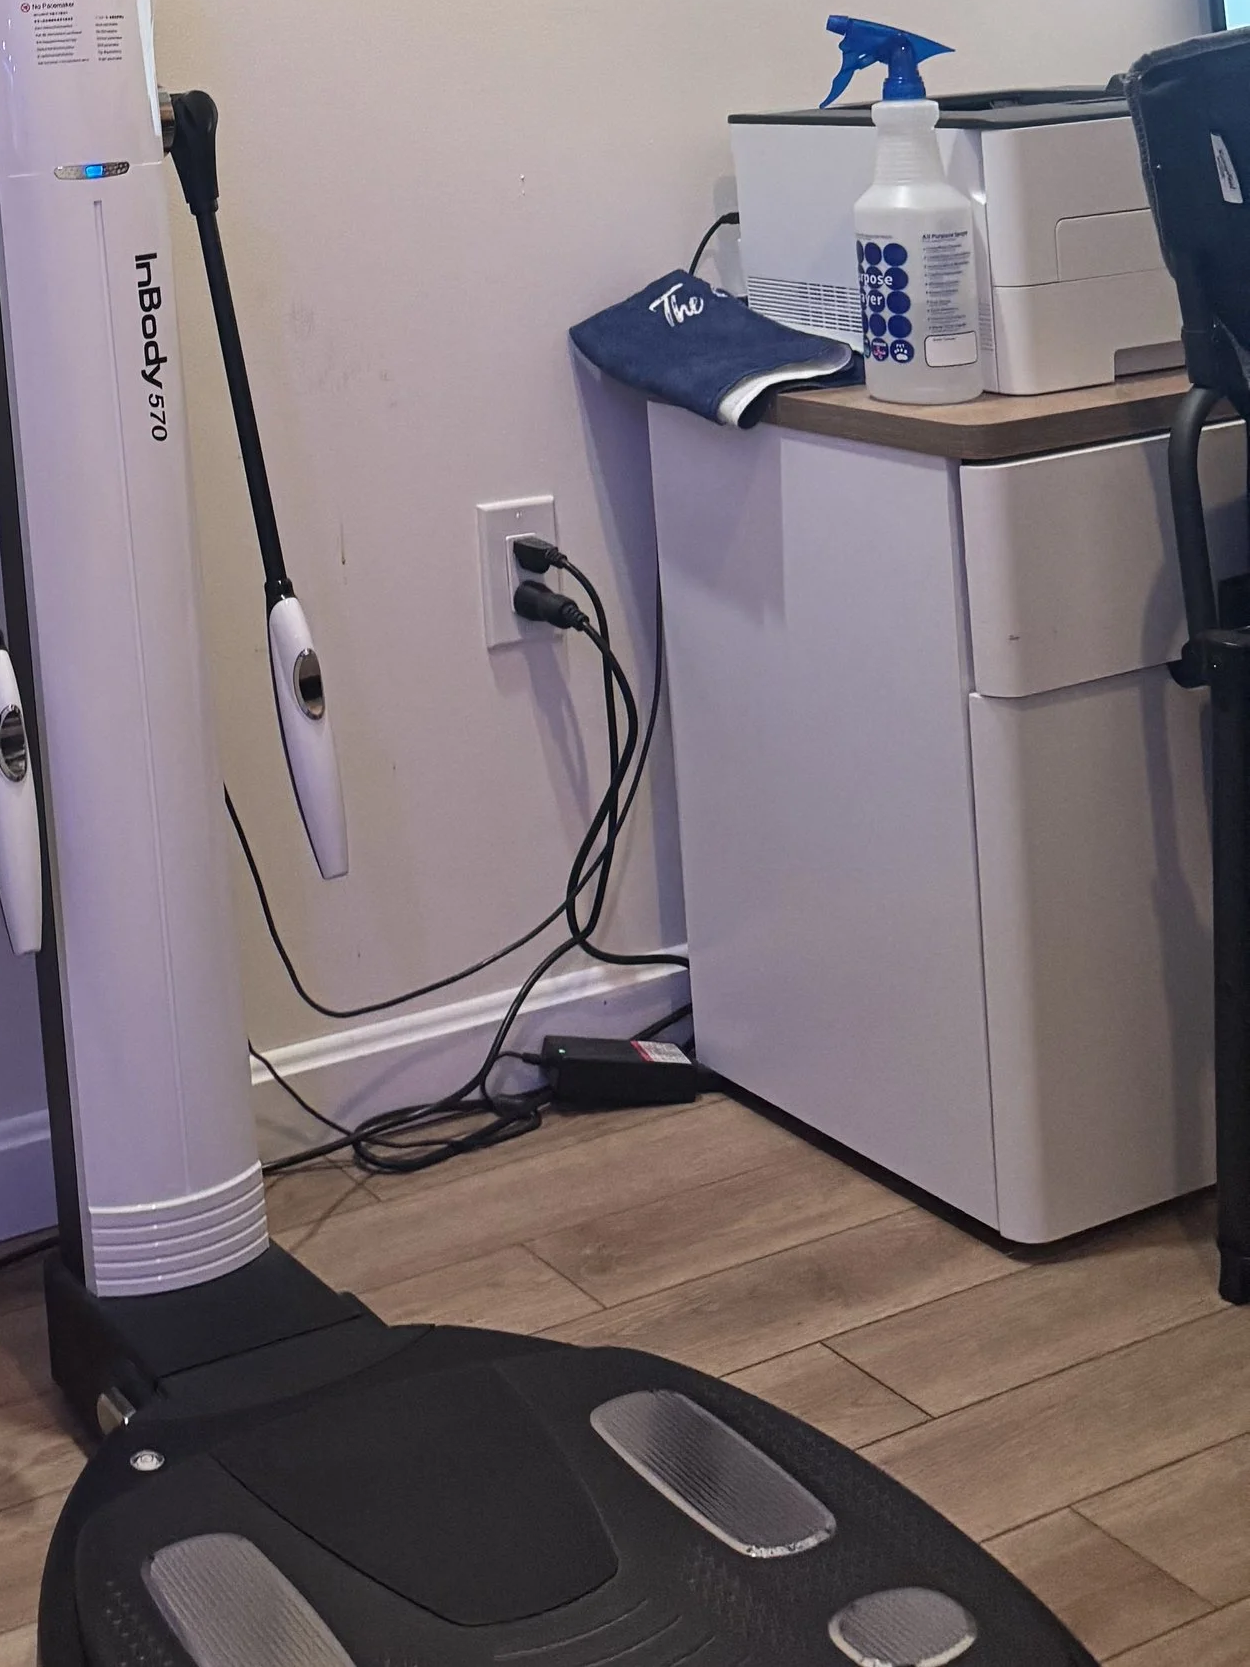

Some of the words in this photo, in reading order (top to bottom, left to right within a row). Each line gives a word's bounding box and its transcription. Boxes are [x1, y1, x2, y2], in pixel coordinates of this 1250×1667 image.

[135, 252, 168, 390] InBody
[648, 282, 704, 327] The
[148, 393, 168, 442] 570
